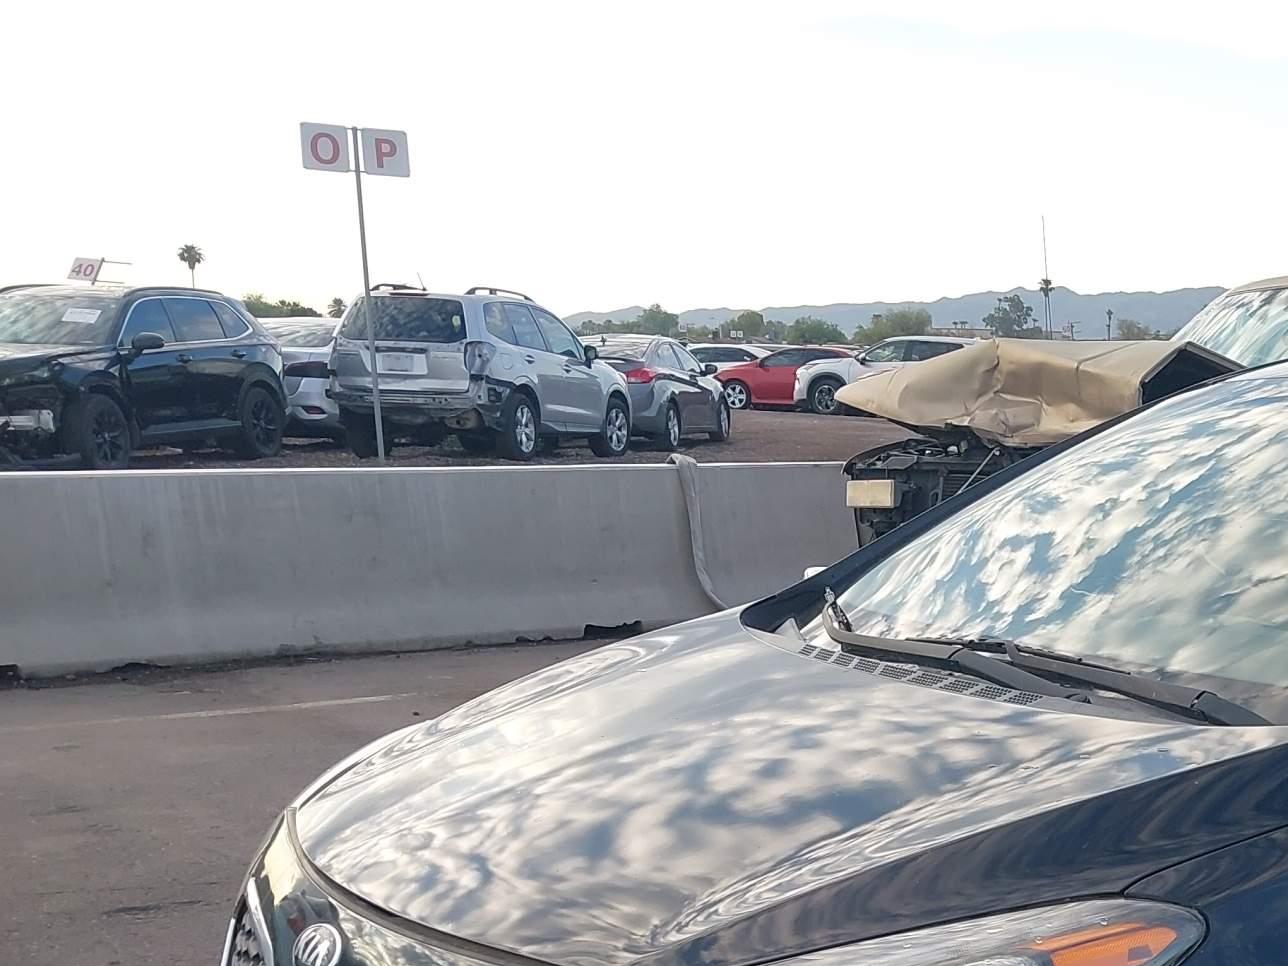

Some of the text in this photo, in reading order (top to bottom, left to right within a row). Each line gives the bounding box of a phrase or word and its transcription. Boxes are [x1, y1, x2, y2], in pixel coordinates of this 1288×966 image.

[310, 132, 340, 165] O
[374, 137, 398, 169] P
[71, 263, 95, 277] 40
